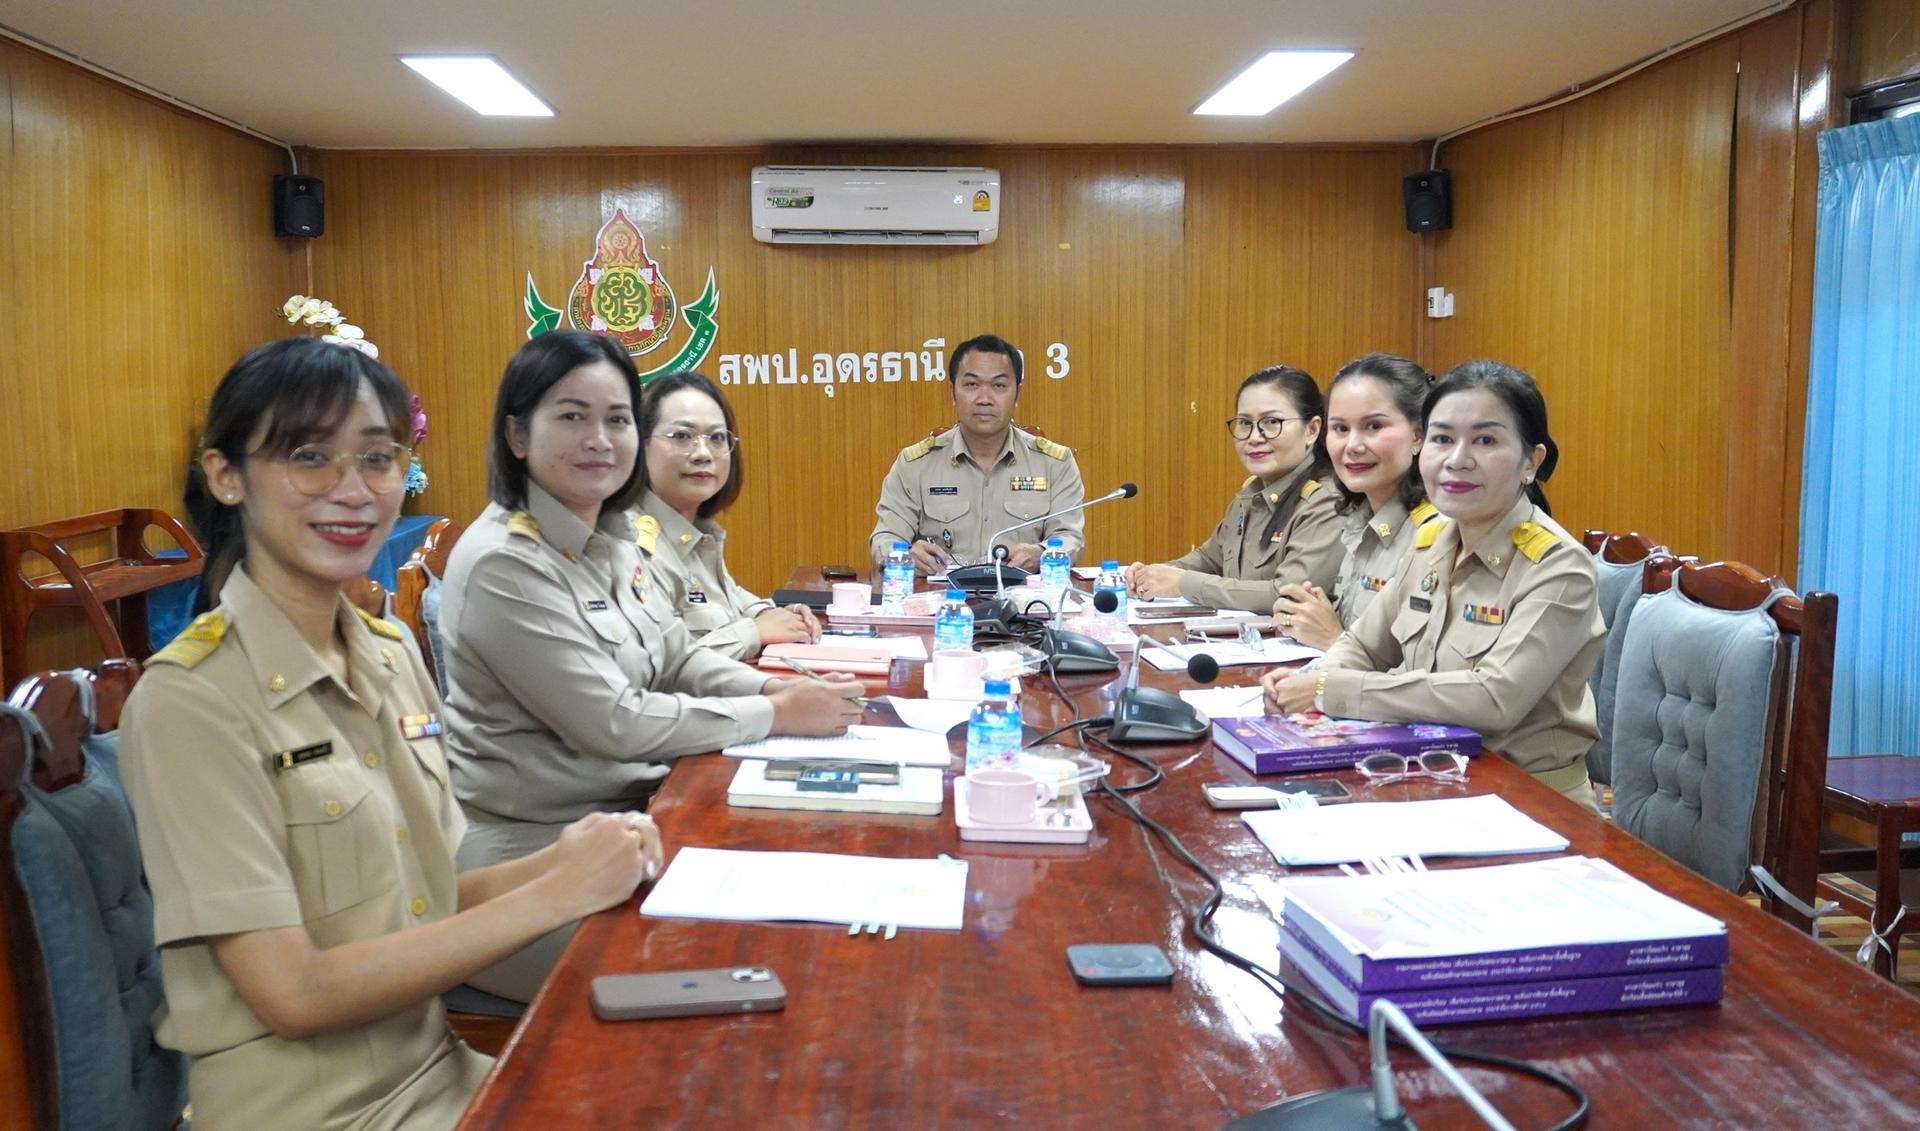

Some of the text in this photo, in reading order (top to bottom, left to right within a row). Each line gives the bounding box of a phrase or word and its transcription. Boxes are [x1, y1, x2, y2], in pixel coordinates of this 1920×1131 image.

[719, 338, 946, 397] สพป.อุดรธานี
[1046, 343, 1070, 379] 3
